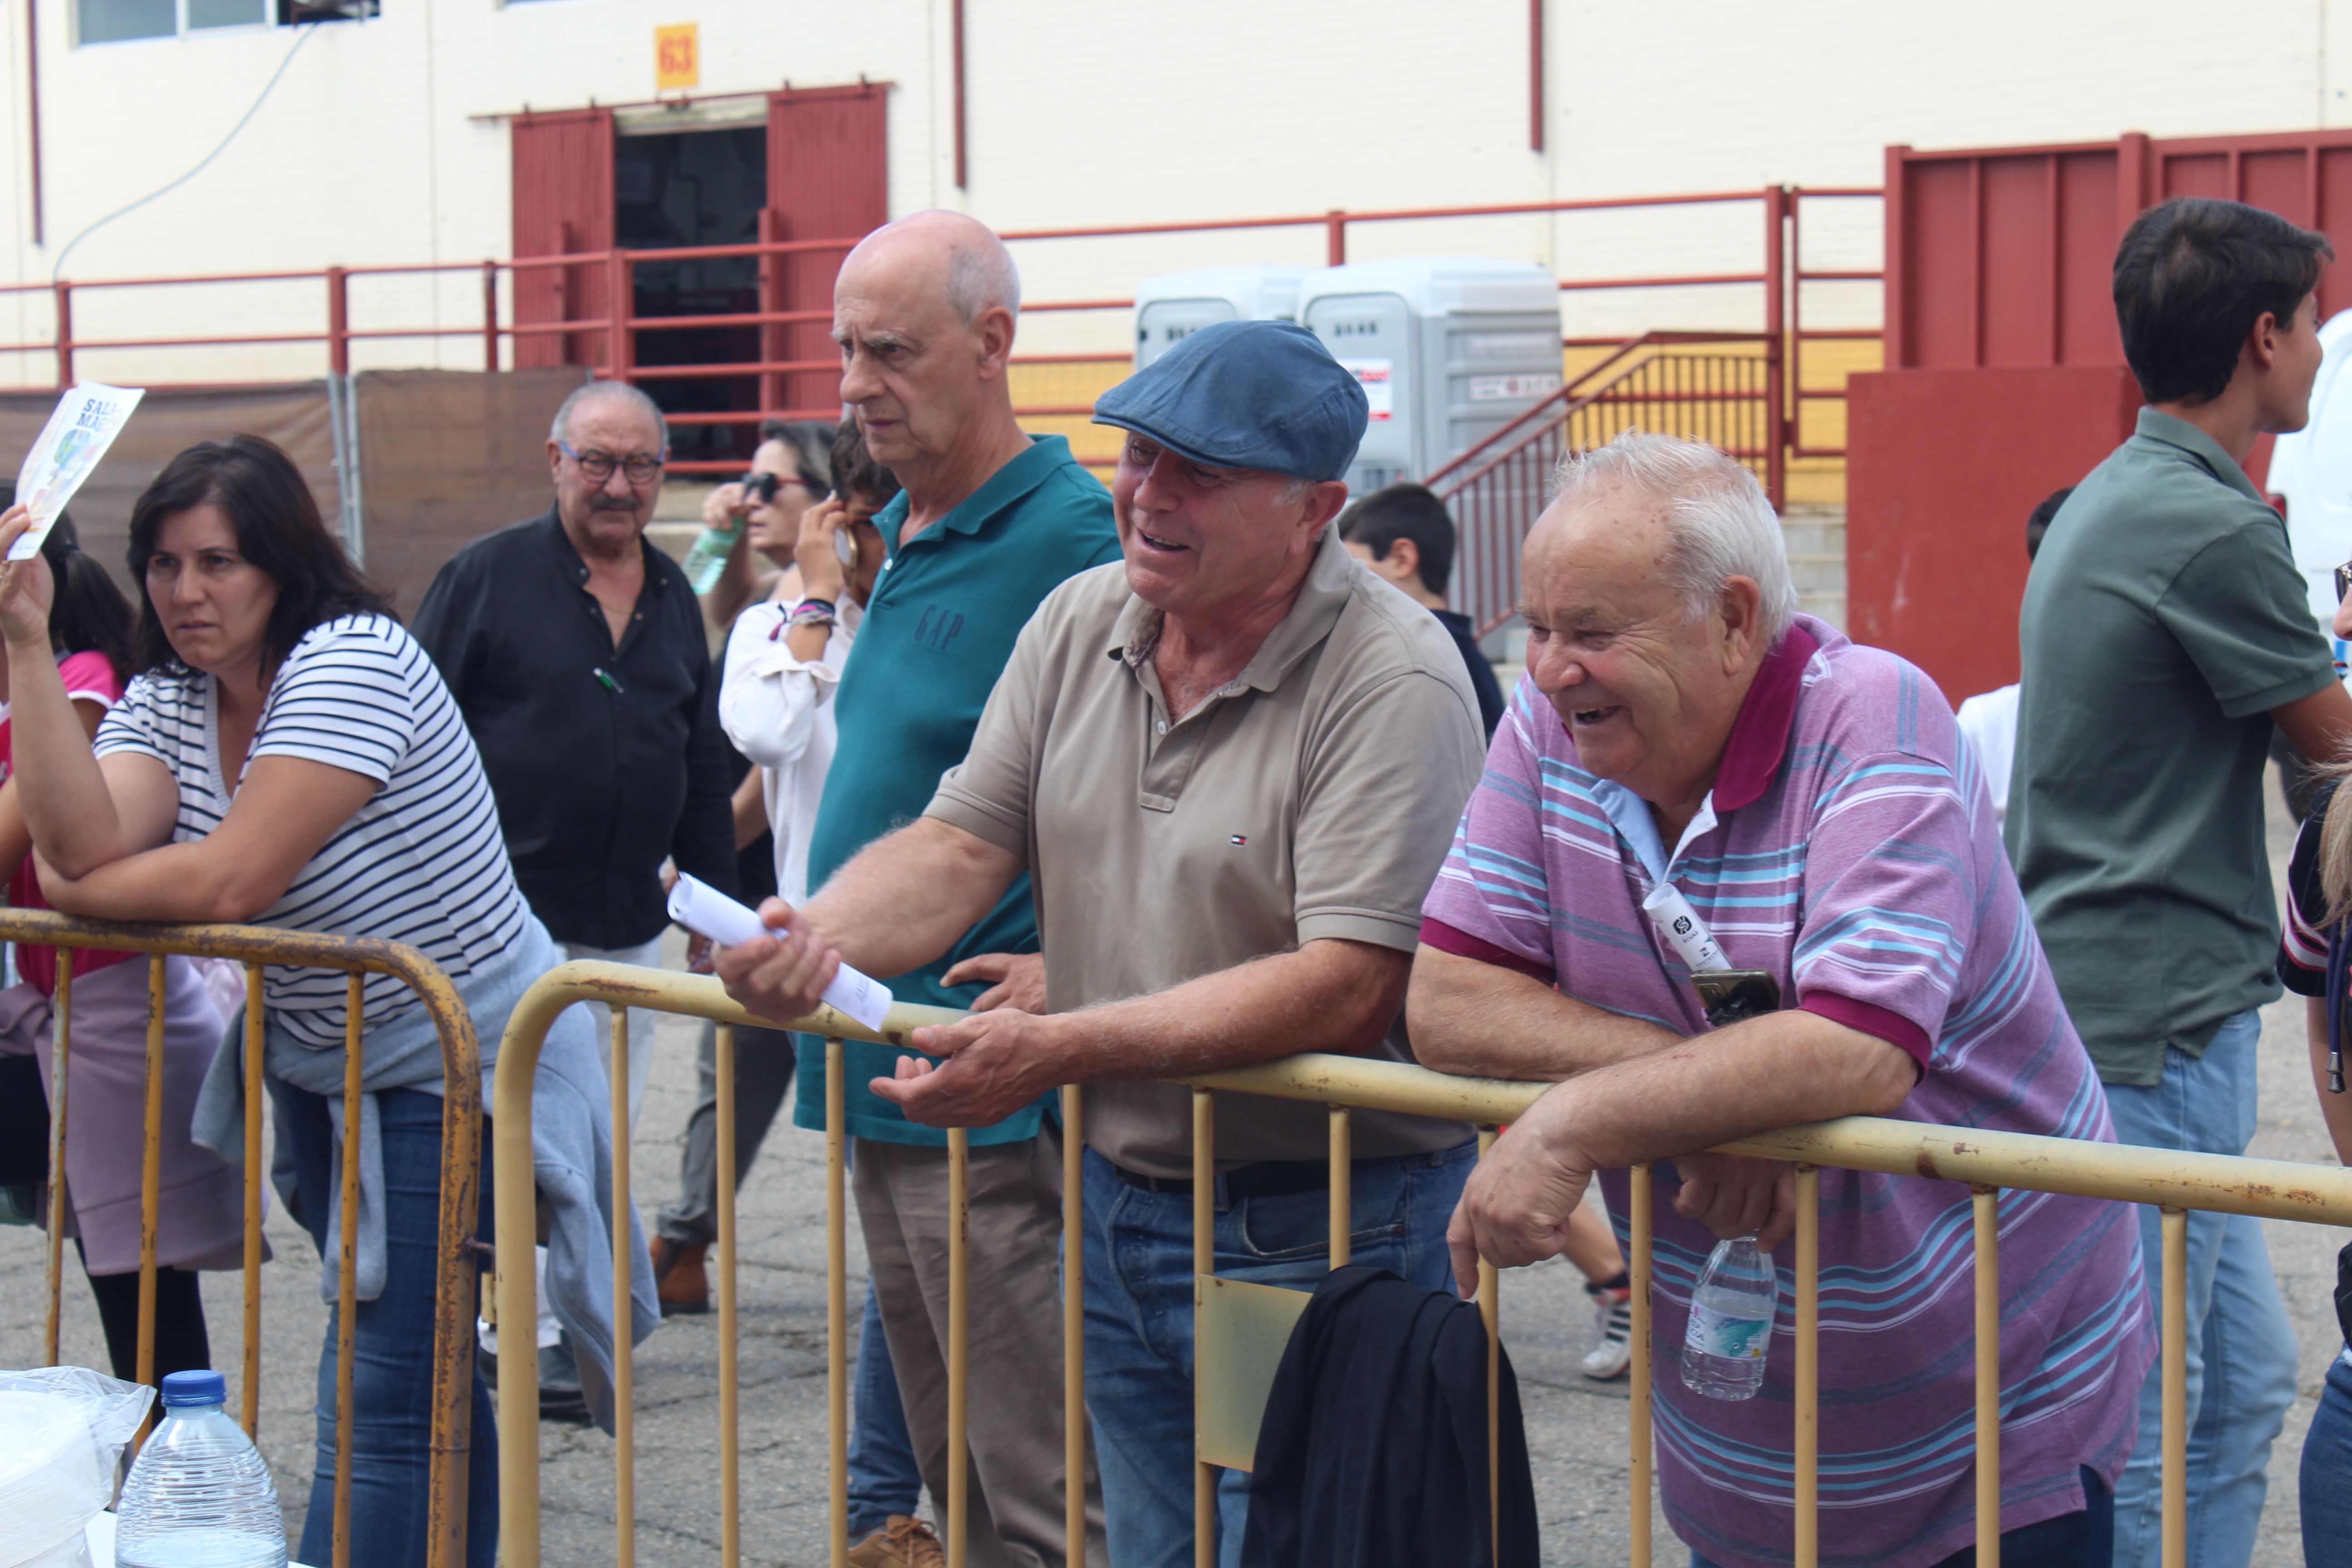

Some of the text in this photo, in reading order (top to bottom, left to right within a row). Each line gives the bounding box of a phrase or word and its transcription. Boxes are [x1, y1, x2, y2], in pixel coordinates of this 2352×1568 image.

[659, 35, 692, 75] 63
[914, 603, 964, 651] GAP
[1682, 930, 1699, 944] RIVAS
